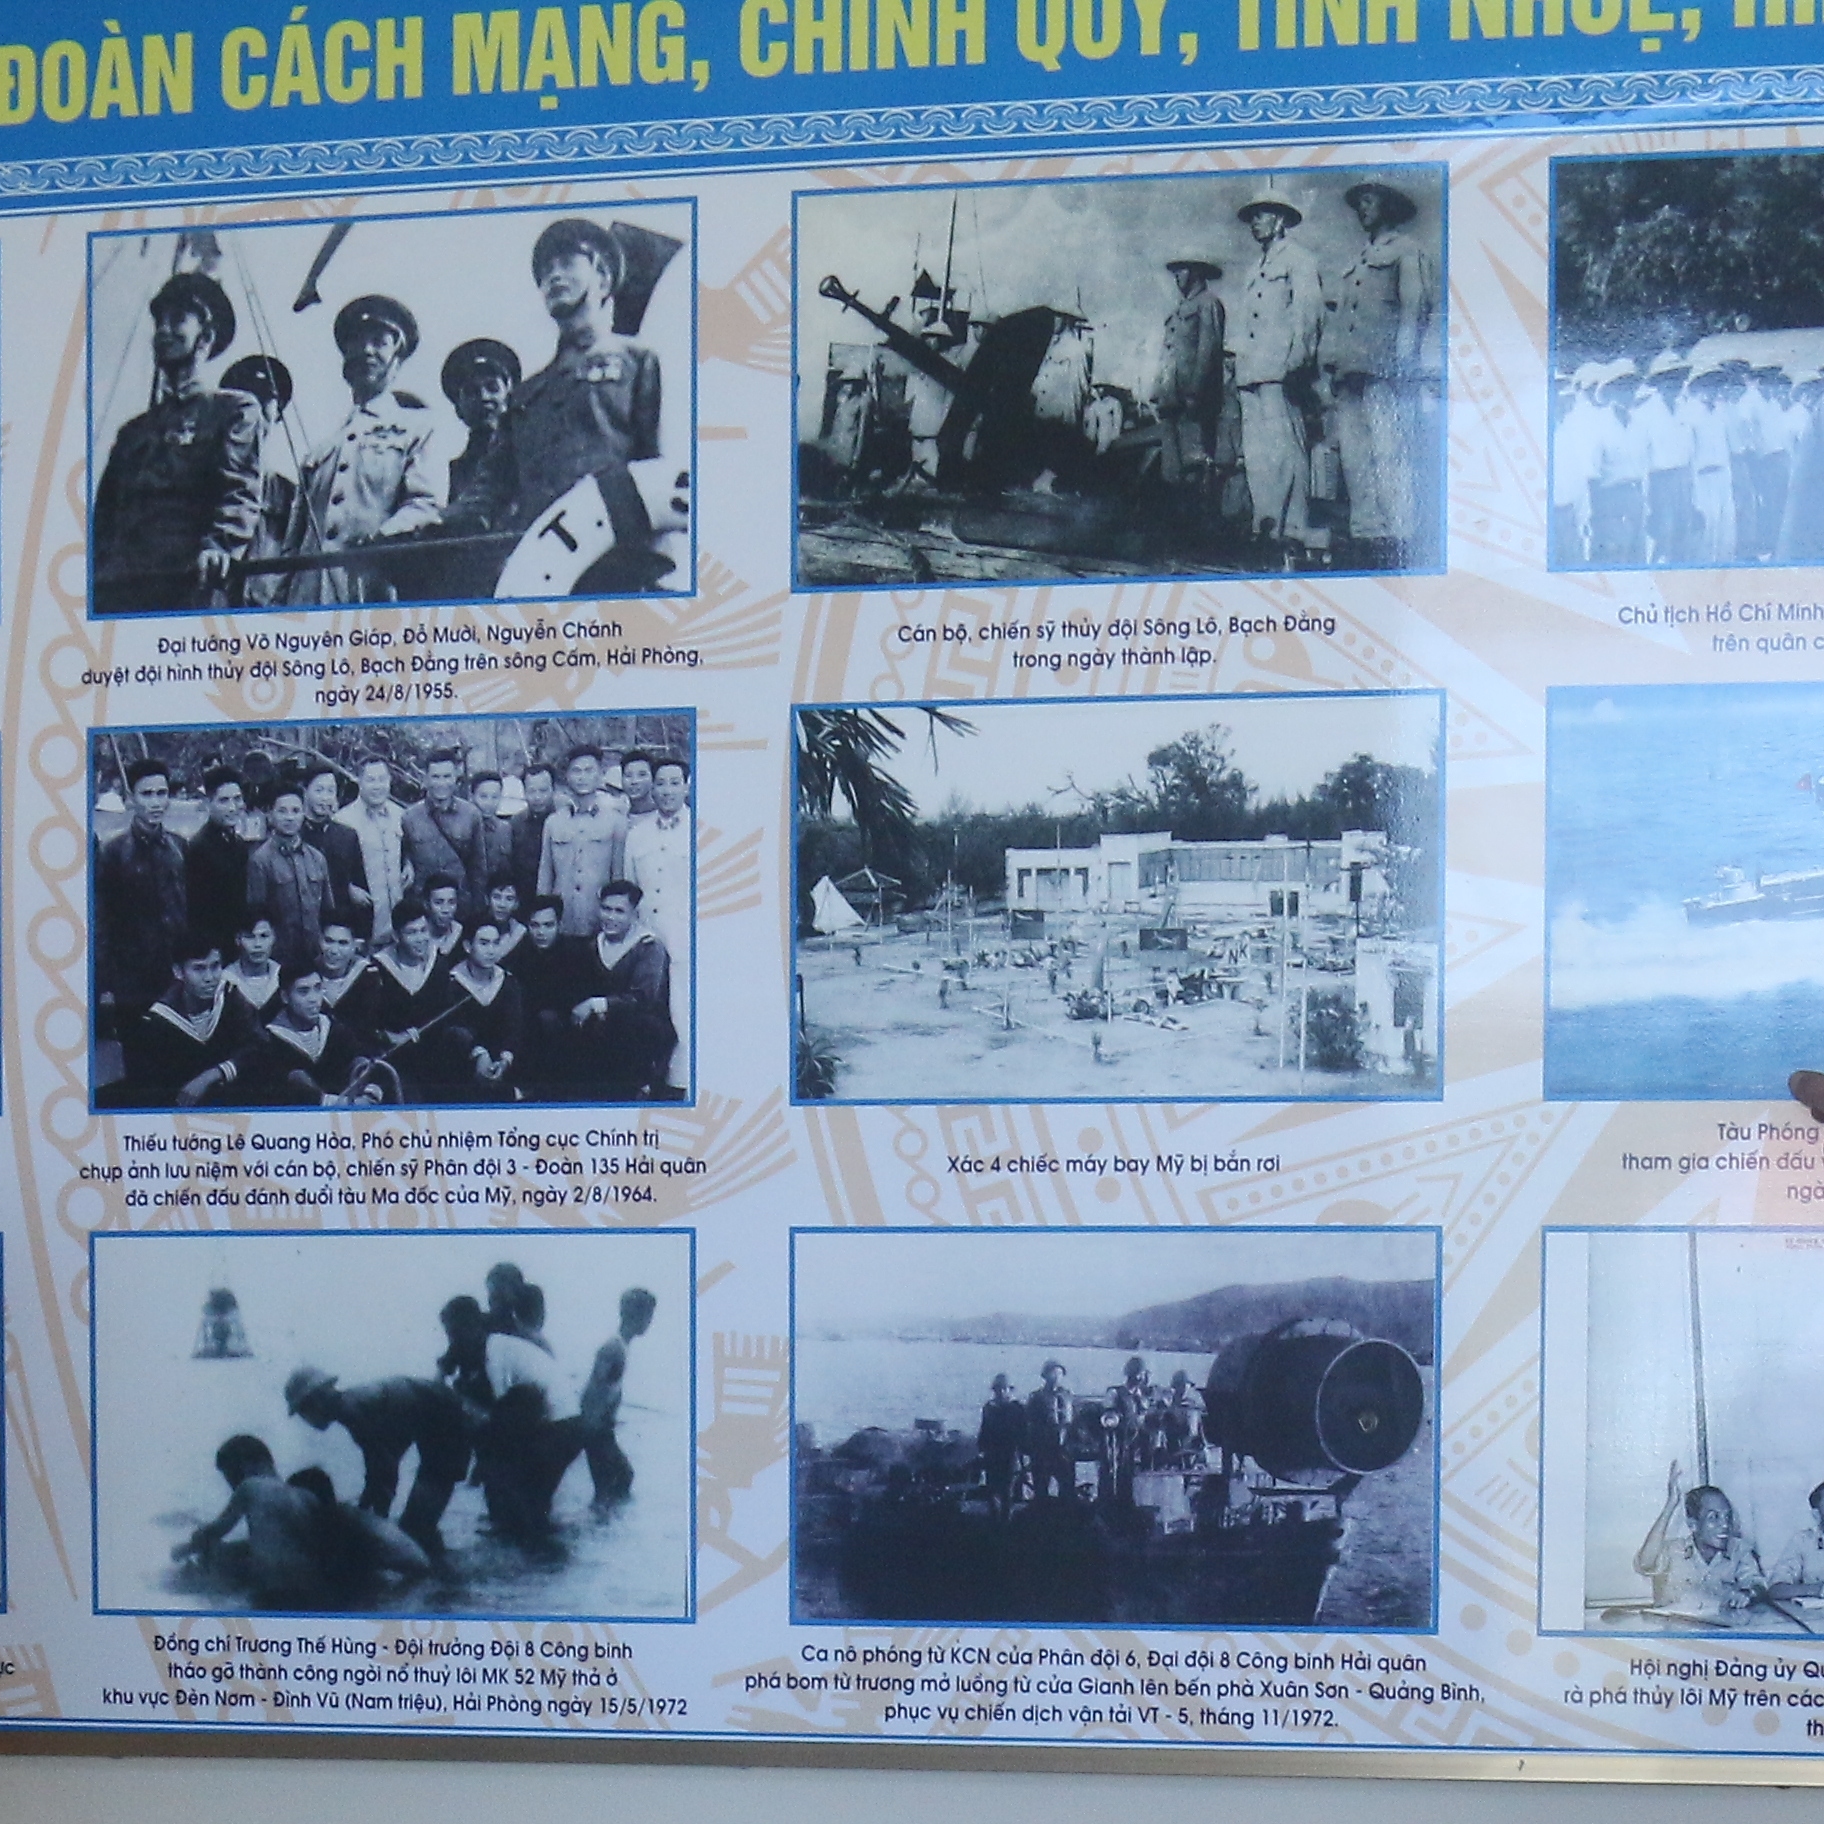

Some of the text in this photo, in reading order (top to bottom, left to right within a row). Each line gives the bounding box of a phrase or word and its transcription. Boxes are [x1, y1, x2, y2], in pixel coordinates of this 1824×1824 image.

[222, 6, 423, 109] CÁCH
[453, 0, 710, 109] MẠNG,
[897, 614, 1336, 645] Cán bộ, chiến sỹ thủy đội Sông Lô, Bạch Đằng
[1617, 602, 1659, 625] Chủ
[1663, 605, 1701, 629] tịch
[1705, 600, 1733, 623] Hồ
[1737, 601, 1772, 623] Chí
[1777, 602, 1824, 621] Minh
[157, 637, 187, 657] Đại
[190, 633, 242, 657] tướng
[275, 630, 344, 654] Nguyên
[348, 627, 397, 649] Giáp,
[402, 623, 429, 645] Đỗ
[432, 624, 481, 644] Mười,
[486, 617, 558, 646] Nguyễn
[561, 619, 623, 640] Chánh
[315, 681, 458, 708] ngày 24/8/1955.
[123, 1126, 659, 1156] Thiếu tướng Lê Quang Hòa, Phó chủ nhiệm Tổng cục Chính trị
[1716, 1121, 1752, 1141] Tàu
[1757, 1122, 1820, 1150] Phóng
[947, 1149, 1281, 1177] Xác 4 chiếc máy bay Mỹ bị bắn rơi
[153, 1632, 200, 1657] Đồng
[203, 1633, 231, 1653] chí
[235, 1635, 293, 1658] Trương
[296, 1635, 327, 1655] Thế
[331, 1636, 377, 1660] Hùng
[393, 1638, 424, 1659] Đội
[427, 1636, 485, 1661] trưởng
[489, 1639, 520, 1661] Đội
[524, 1639, 535, 1658] 8
[539, 1640, 589, 1663] Công
[593, 1641, 633, 1659] binh
[1630, 1658, 1661, 1680] Hội
[1666, 1659, 1709, 1682] nghị
[1713, 1656, 1769, 1683] Đảng
[1773, 1657, 1797, 1682] ủy
[884, 1702, 932, 1724] phục
[936, 1705, 959, 1725] vụ
[963, 1701, 1017, 1722] chiến
[1021, 1704, 1063, 1726] dịch
[1068, 1705, 1104, 1727] vận
[1108, 1702, 1133, 1724] tải
[1137, 1706, 1160, 1724] VT
[1177, 1707, 1194, 1727] 5,
[1199, 1706, 1255, 1731] tháng
[1262, 1708, 1339, 1729] 11/1972.
